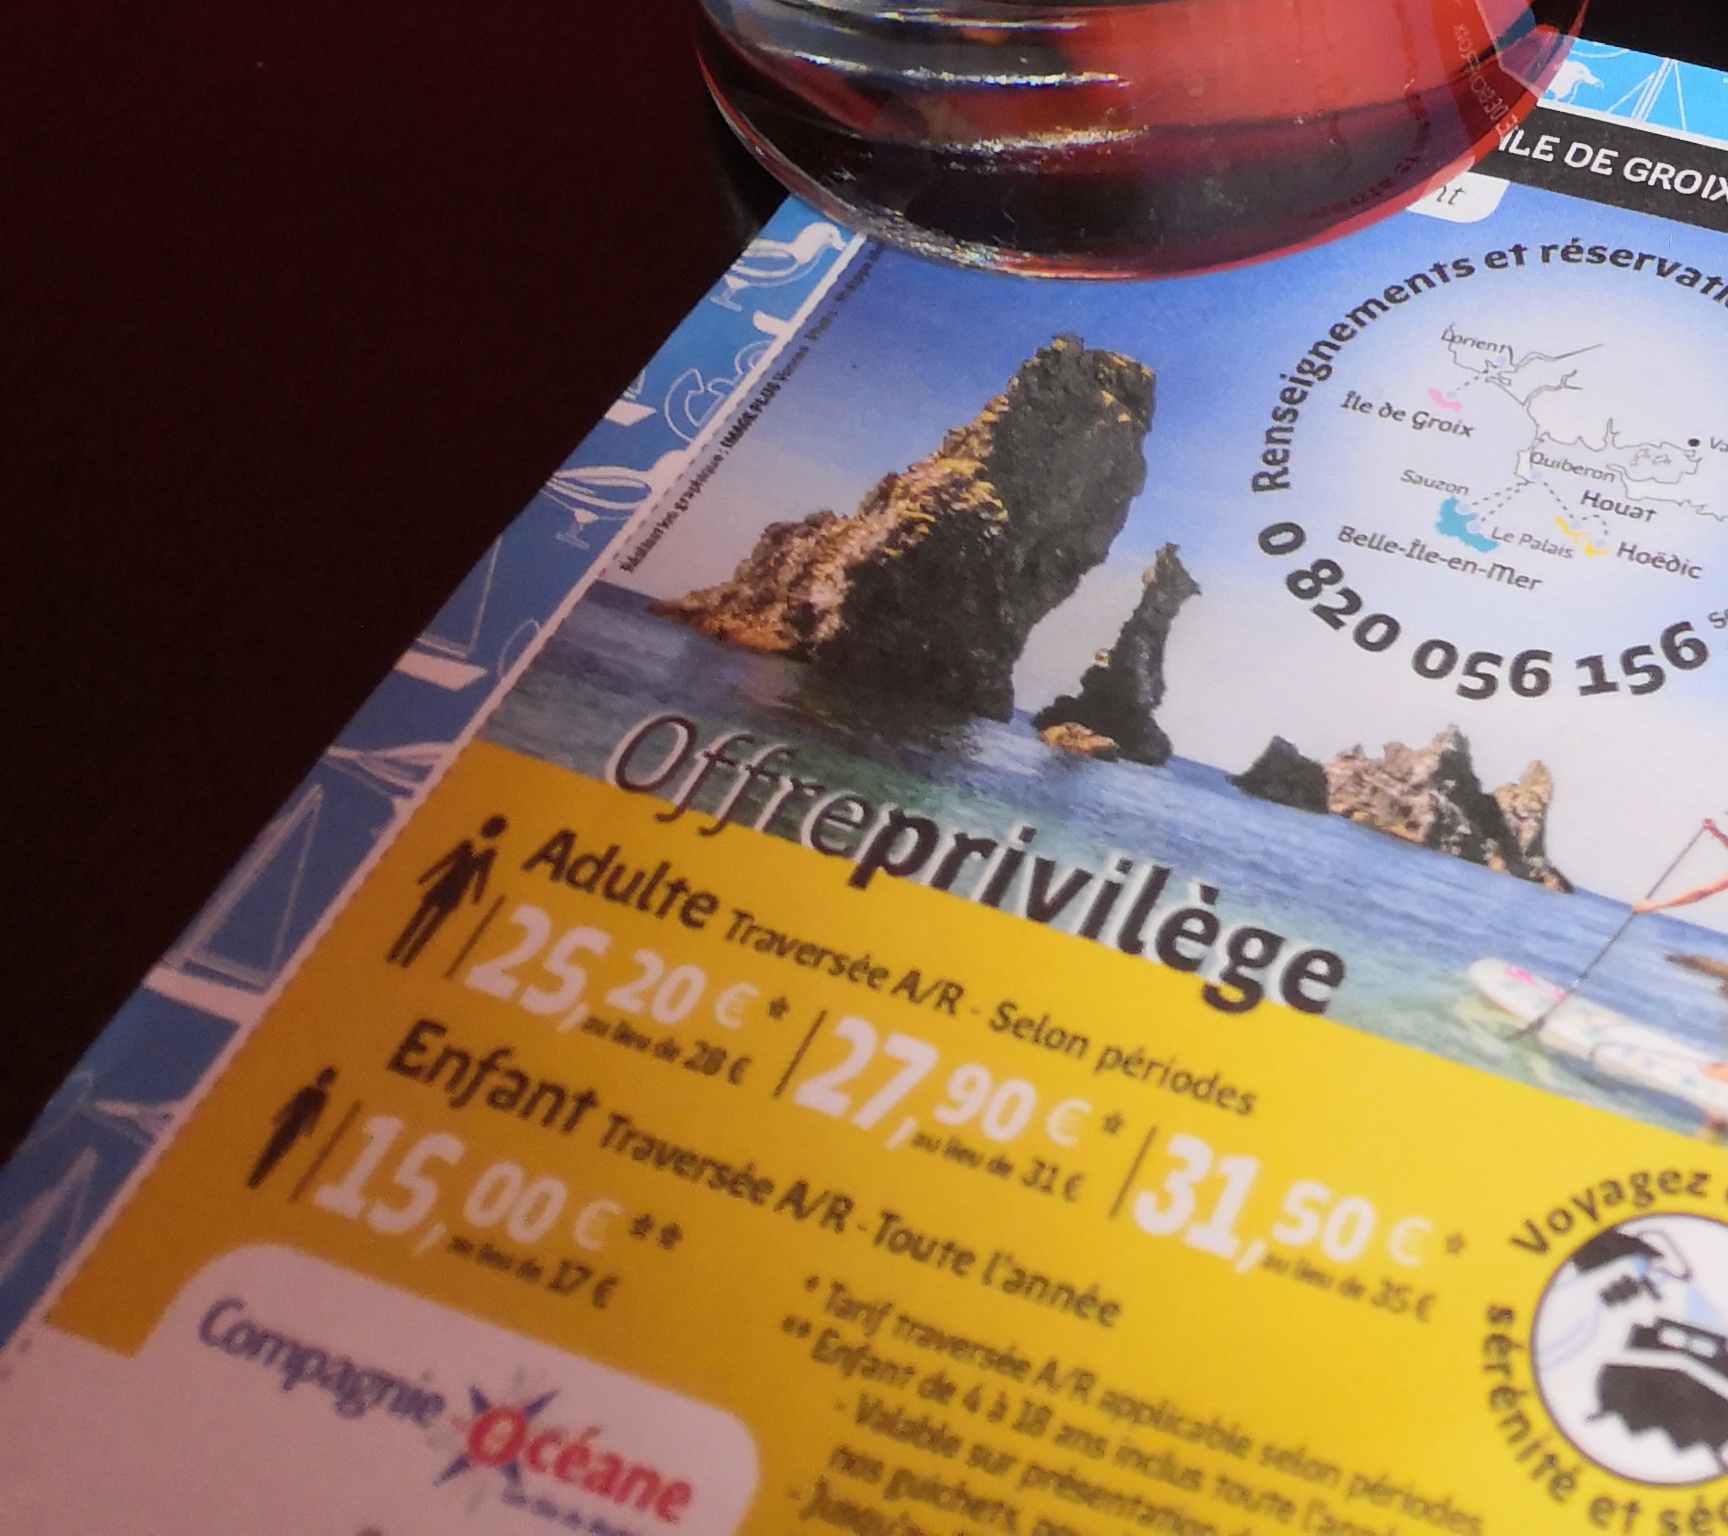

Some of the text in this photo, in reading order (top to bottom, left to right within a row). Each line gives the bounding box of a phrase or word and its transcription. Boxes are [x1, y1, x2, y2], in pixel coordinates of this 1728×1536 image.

[1564, 141, 1619, 177] DE
[1441, 328, 1511, 353] Lorient
[1251, 255, 1476, 494] Renseignements
[1484, 243, 1528, 270] et
[1377, 401, 1407, 423] de
[1411, 409, 1475, 438] Groix
[1400, 469, 1470, 496] Sauzon
[1530, 450, 1616, 483] Quiberon
[1580, 489, 1657, 524] Houat
[1490, 527, 1575, 560] Le Palais
[1616, 541, 1704, 580] Hoëdic
[1257, 521, 1711, 701] 0 820 056 156
[522, 828, 1257, 1118] Adulte Traversée A/R Selon périodes
[387, 1018, 1123, 1329] Enfant Traversée A/R Toute l'année
[1510, 1168, 1711, 1257] Voyagez
[199, 1297, 446, 1428] Compagnie
[467, 1405, 693, 1526] Océane
[1482, 1304, 1582, 1503] sérénité
[1588, 1494, 1640, 1530] et
